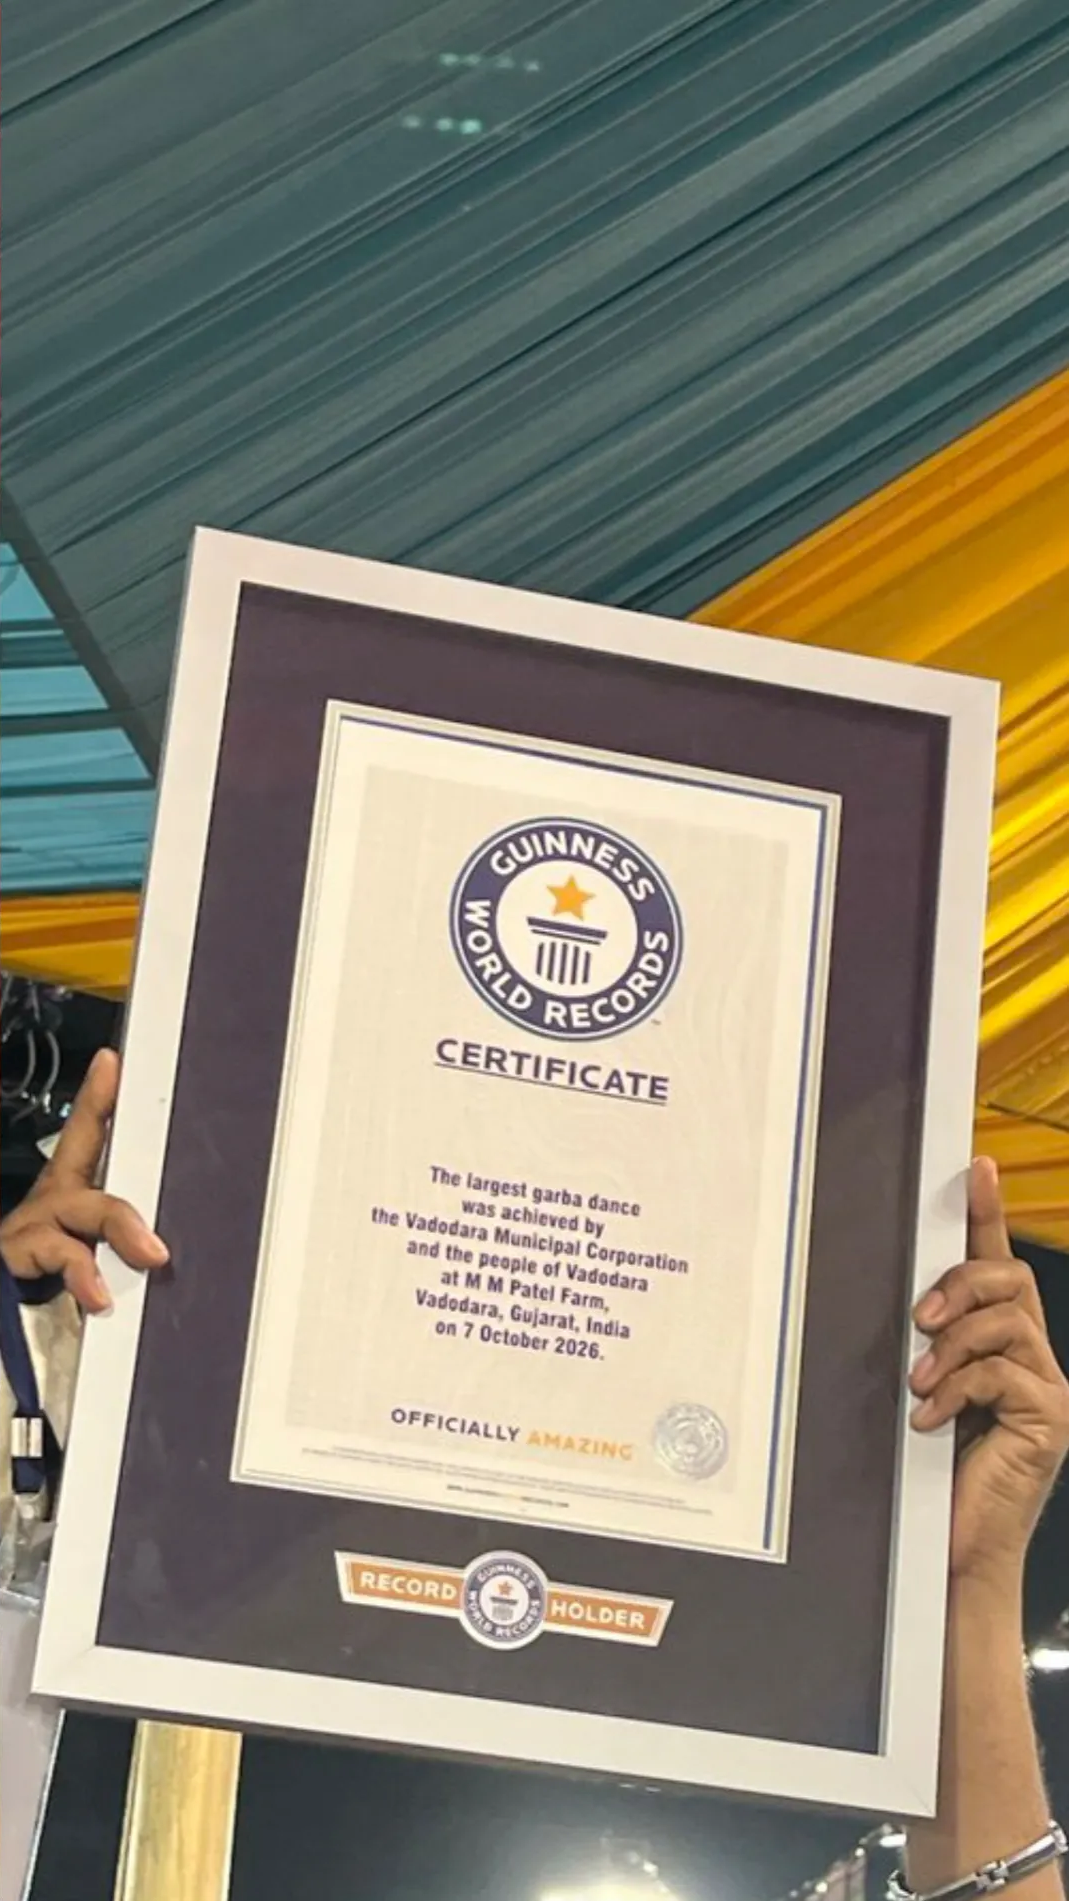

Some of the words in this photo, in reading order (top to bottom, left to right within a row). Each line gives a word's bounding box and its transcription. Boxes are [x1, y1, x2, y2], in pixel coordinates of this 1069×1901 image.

[490, 830, 655, 902] GUINNESS
[464, 900, 531, 1010] WORLD
[543, 930, 669, 1028] RECORDS
[436, 1038, 669, 1100] CERTIFICATE
[430, 1165, 460, 1187] The
[466, 1172, 528, 1198] largest
[532, 1187, 582, 1207] garba
[588, 1194, 640, 1217] dance
[372, 1207, 399, 1226] the
[405, 1212, 488, 1241] Vadodara
[494, 1227, 580, 1257] Municipal
[587, 1242, 688, 1274] Corporation
[462, 1199, 495, 1218] was
[501, 1202, 578, 1232] achieved
[585, 1219, 605, 1239] by
[407, 1240, 439, 1258] and
[446, 1245, 472, 1264] the
[479, 1251, 537, 1274] people
[543, 1259, 561, 1277] of
[567, 1264, 648, 1292] Vadodara
[441, 1271, 458, 1286] at
[465, 1274, 480, 1290] M
[487, 1277, 503, 1293] M
[510, 1281, 554, 1302] Patel
[561, 1288, 609, 1313] Farm,
[416, 1289, 503, 1322] Vadodara,
[510, 1305, 579, 1333] Gujarat,
[587, 1317, 630, 1339] India
[435, 1321, 456, 1336] on
[463, 1322, 473, 1338] 7
[480, 1326, 549, 1351] October
[555, 1337, 605, 1361] 2026.
[391, 1408, 520, 1442] OFFICIALLY
[526, 1430, 634, 1461] AMAZING
[360, 1571, 457, 1600] RECORD
[551, 1599, 645, 1630] HOLDER
